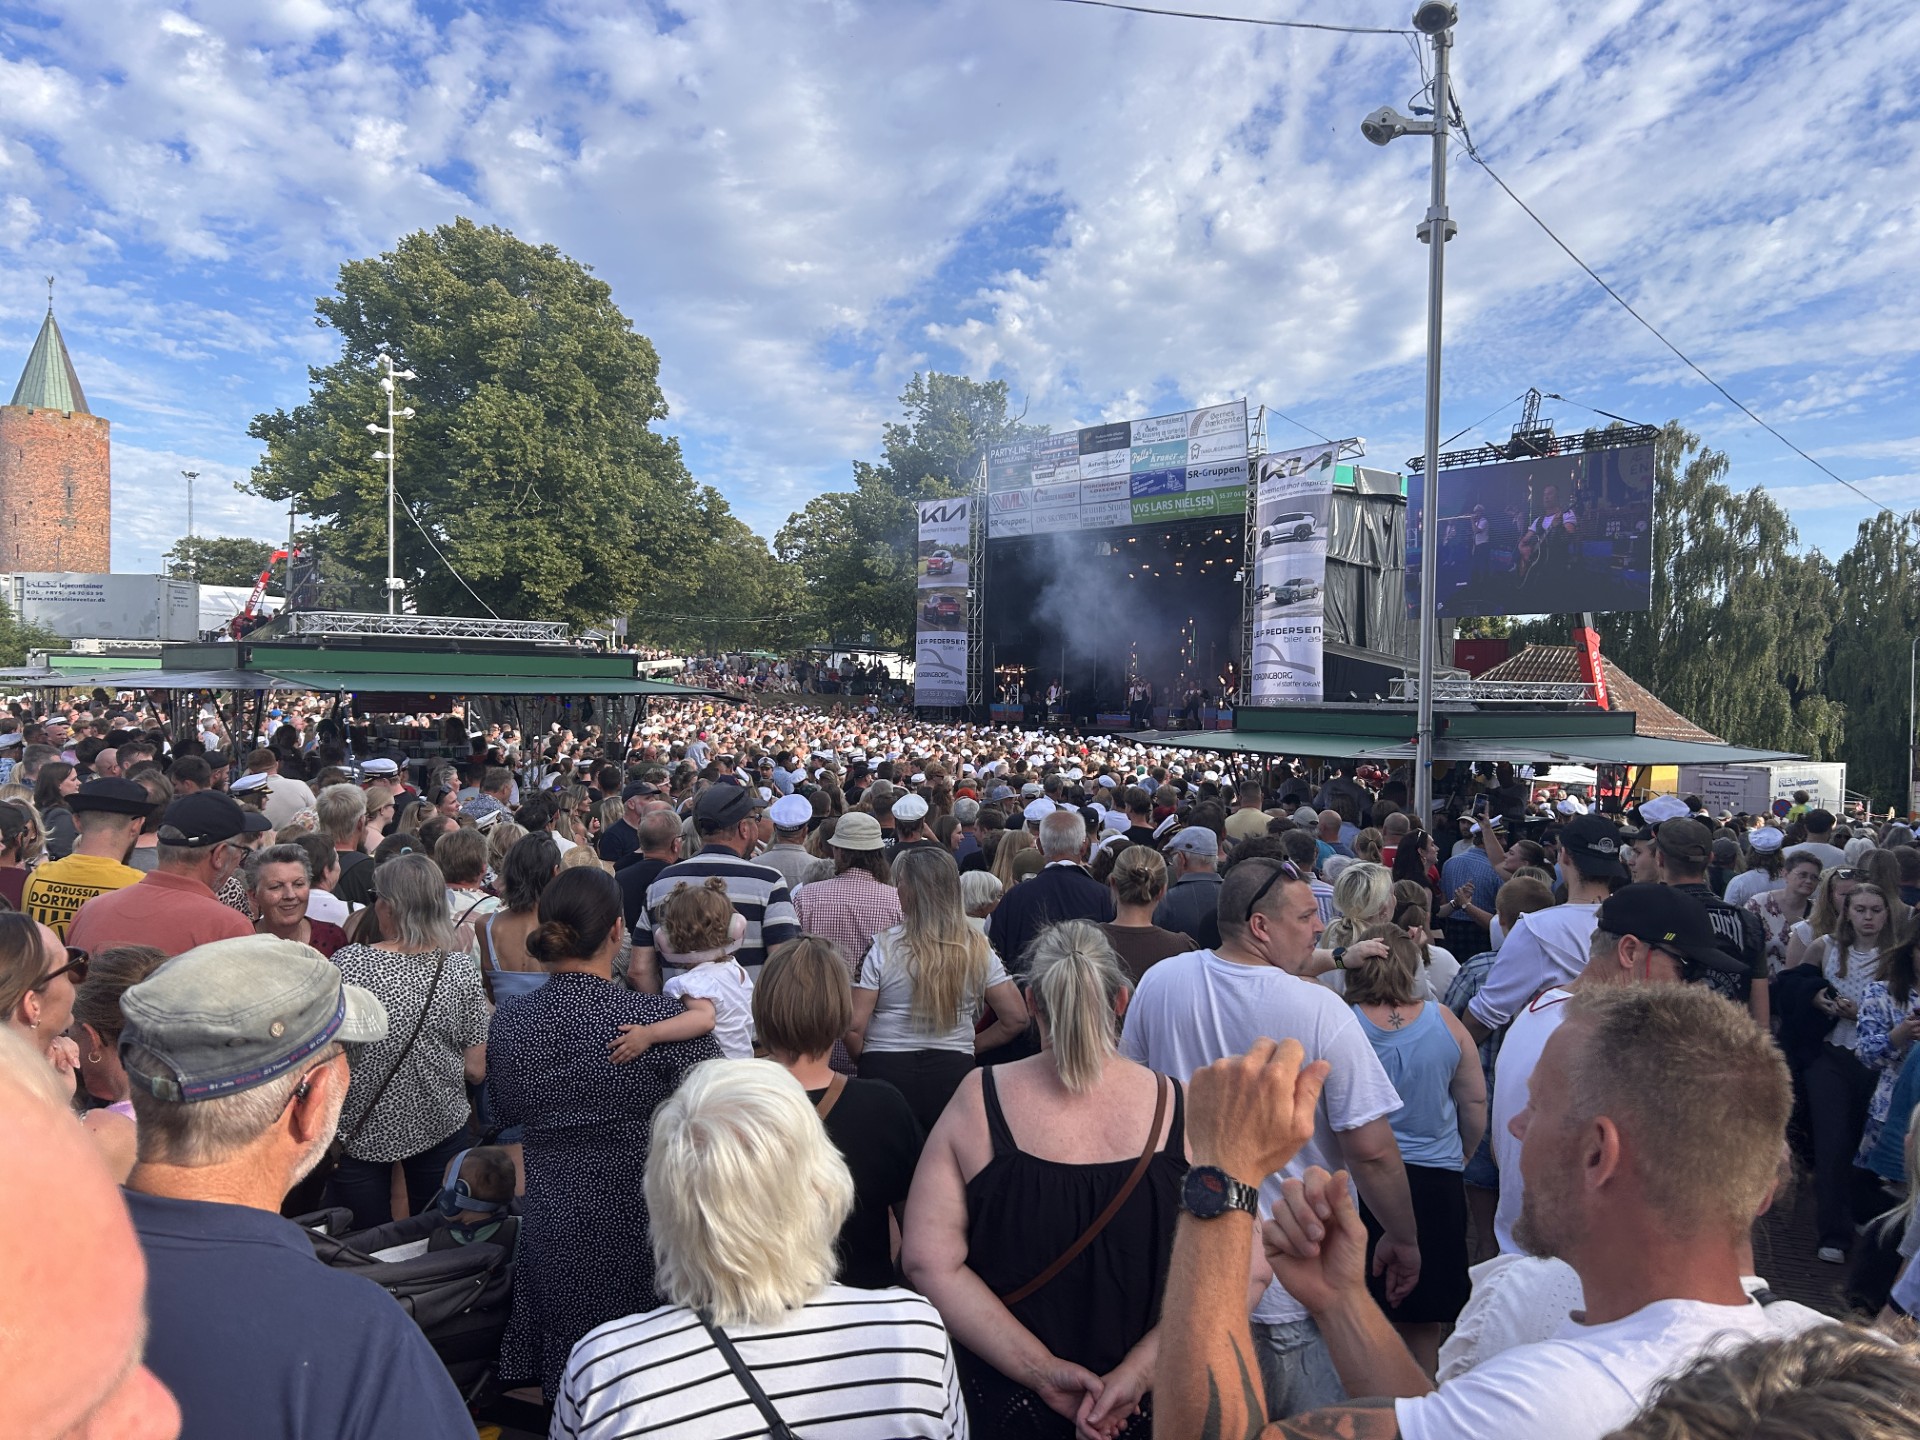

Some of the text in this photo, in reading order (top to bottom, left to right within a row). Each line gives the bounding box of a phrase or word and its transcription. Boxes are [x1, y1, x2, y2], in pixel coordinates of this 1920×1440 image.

[990, 444, 1031, 459] PARTY-LINE
[1260, 450, 1332, 484] KIA
[1132, 502, 1149, 514] VVS
[1150, 499, 1173, 512] LARS
[1174, 495, 1214, 509] NIELSEN
[921, 503, 966, 524] KIA
[1254, 626, 1321, 639] LEIF PEDERSEN
[1254, 672, 1293, 681] ORDINGBORG
[1593, 660, 1605, 699] LOXAM
[30, 891, 86, 908] DORTM
[46, 884, 100, 898] BORUSSIA
